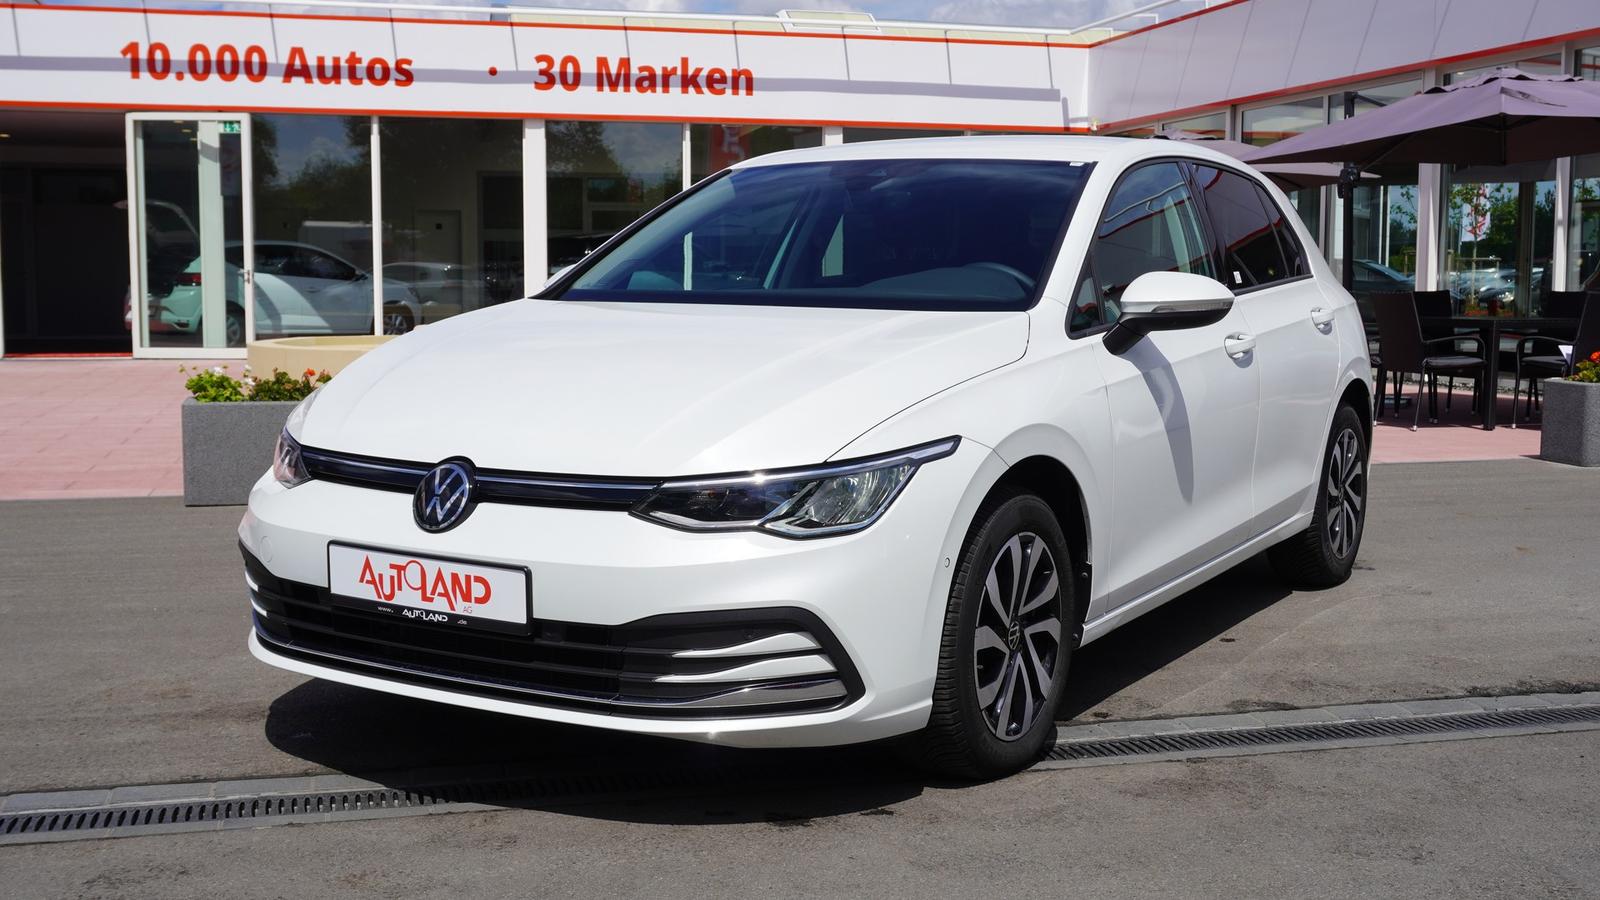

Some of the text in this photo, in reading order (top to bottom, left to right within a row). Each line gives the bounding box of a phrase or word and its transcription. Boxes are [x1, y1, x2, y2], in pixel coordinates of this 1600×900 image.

[121, 41, 754, 97] 10.000 Autos 30 Marken
[462, 605, 473, 614] AG
